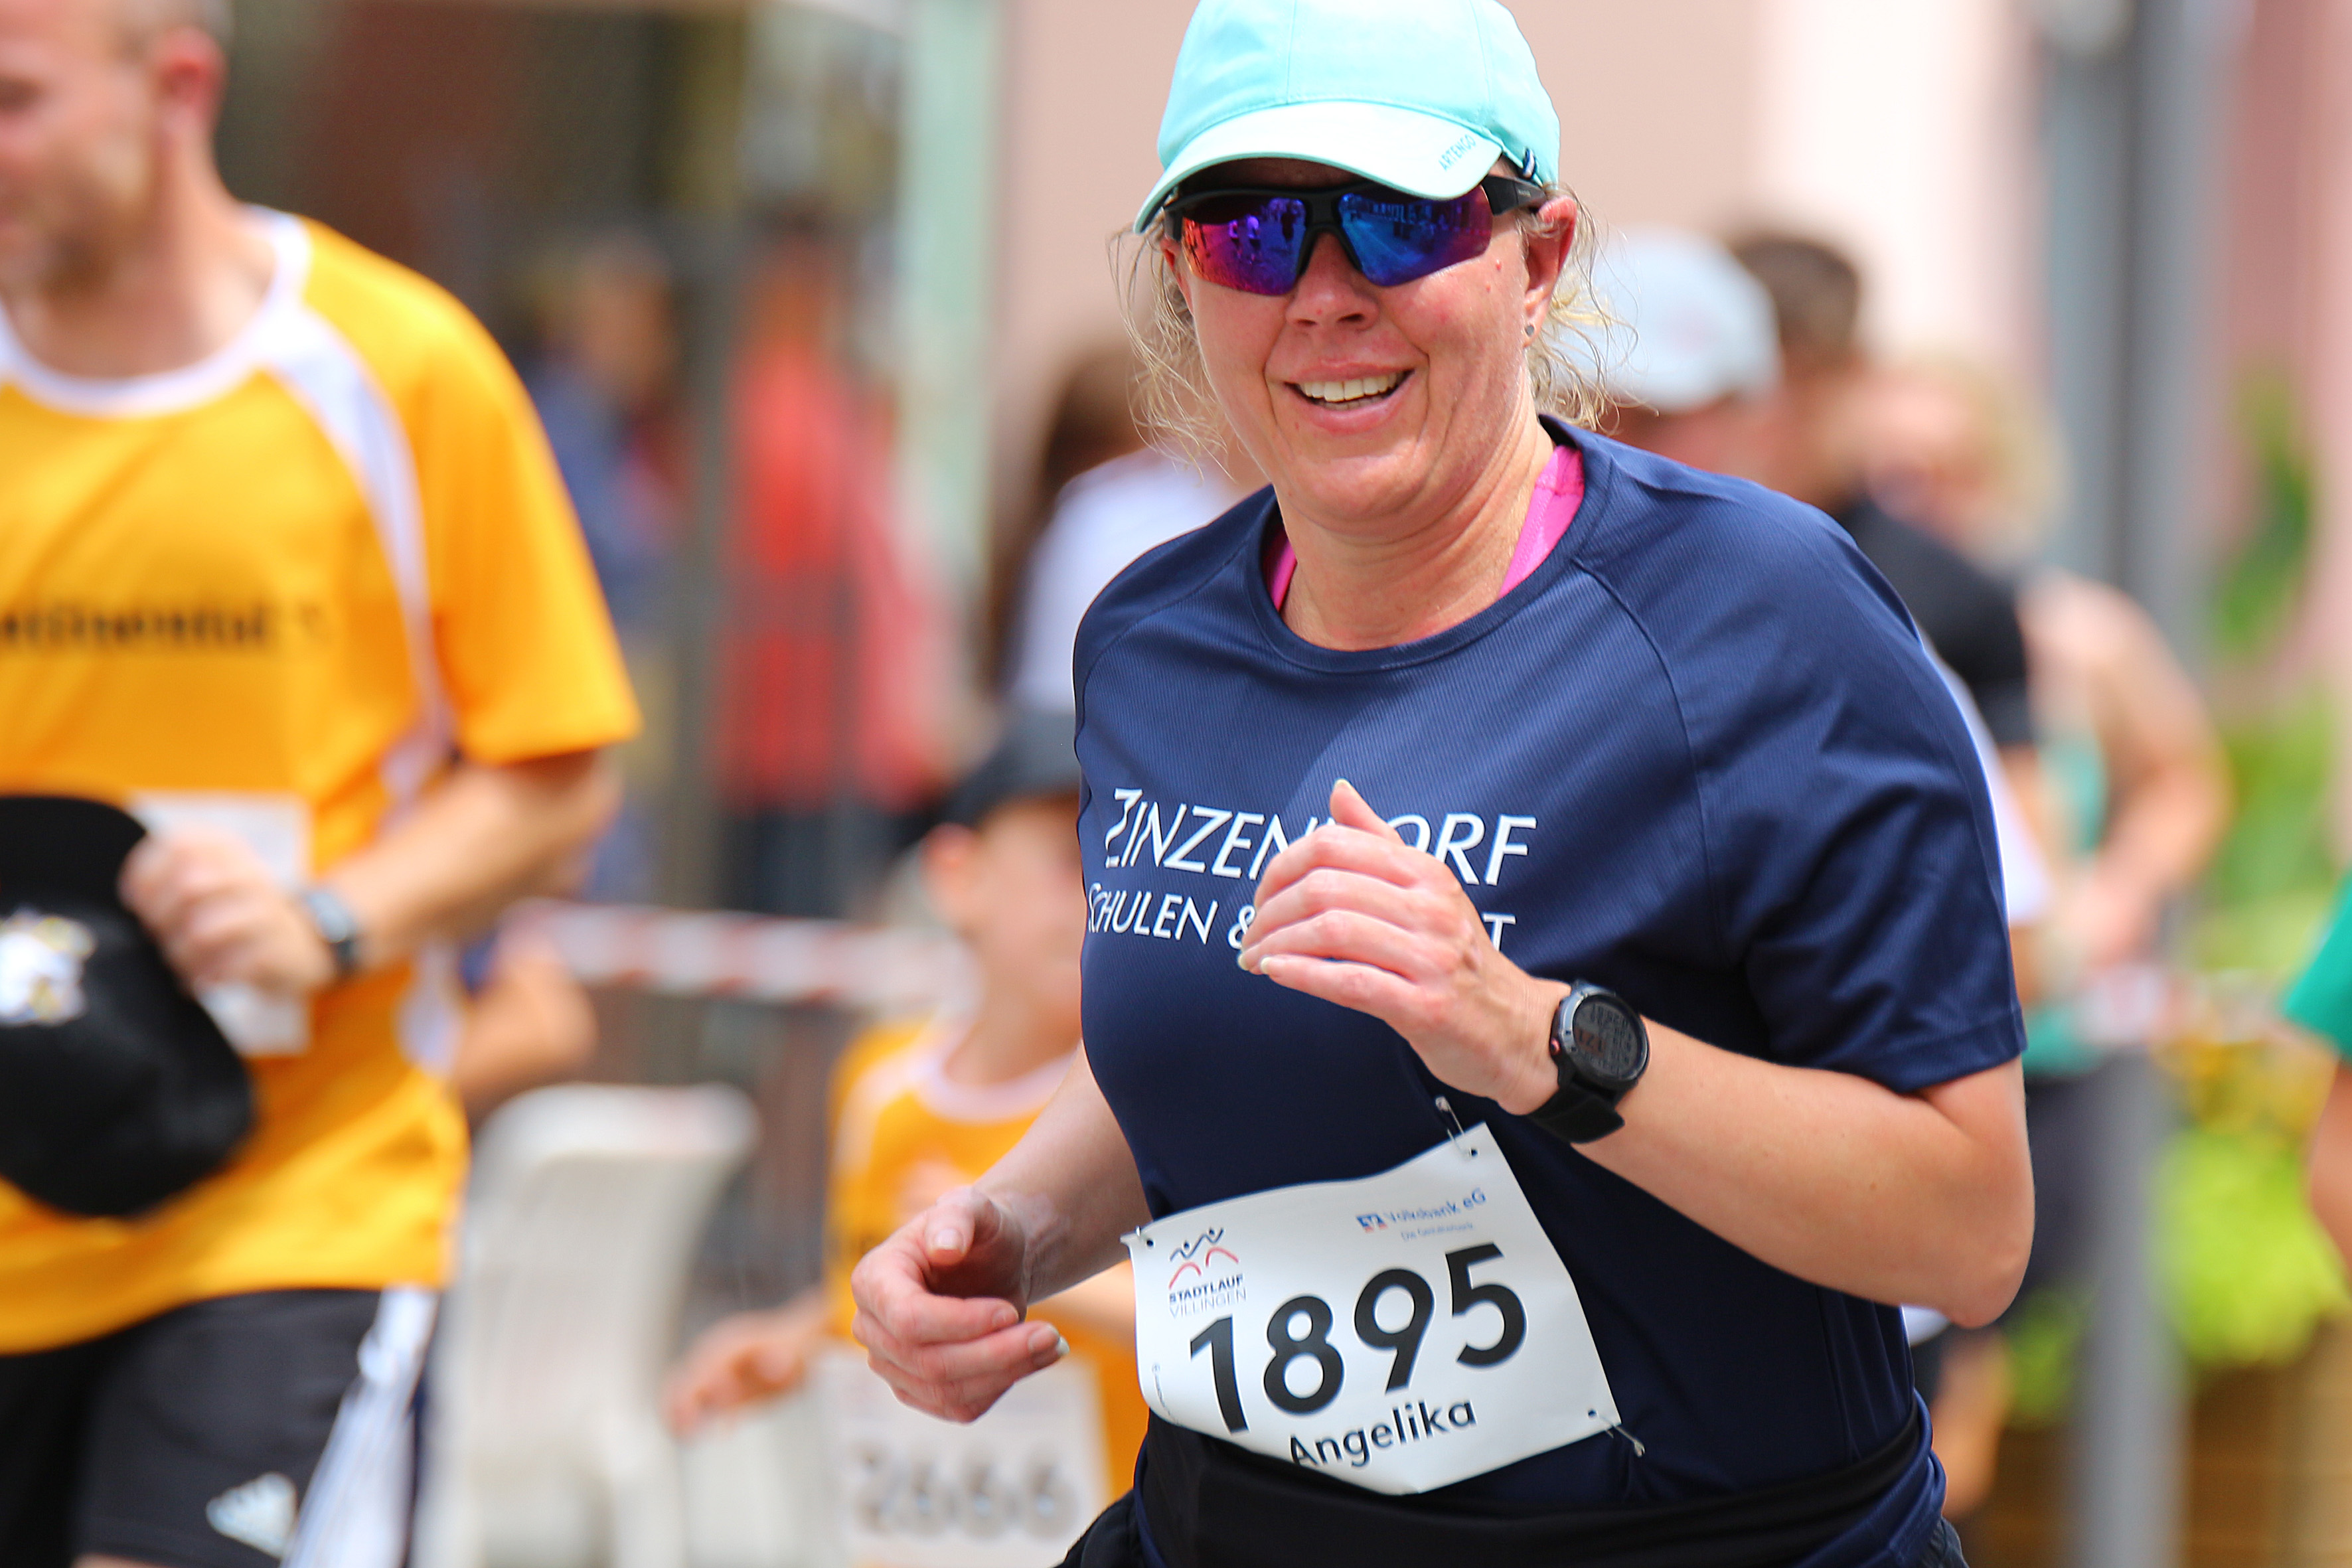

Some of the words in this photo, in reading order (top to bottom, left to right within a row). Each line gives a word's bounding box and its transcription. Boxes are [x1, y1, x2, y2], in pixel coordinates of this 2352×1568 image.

[1438, 133, 1476, 171] ARTENGO
[1105, 788, 1537, 886] ZINZENORF
[1169, 1274, 1243, 1303] STADTLAUF
[1169, 1287, 1247, 1318] VILLINGEN
[1190, 1242, 1526, 1436] 1895
[1289, 1399, 1478, 1468] Angelika
